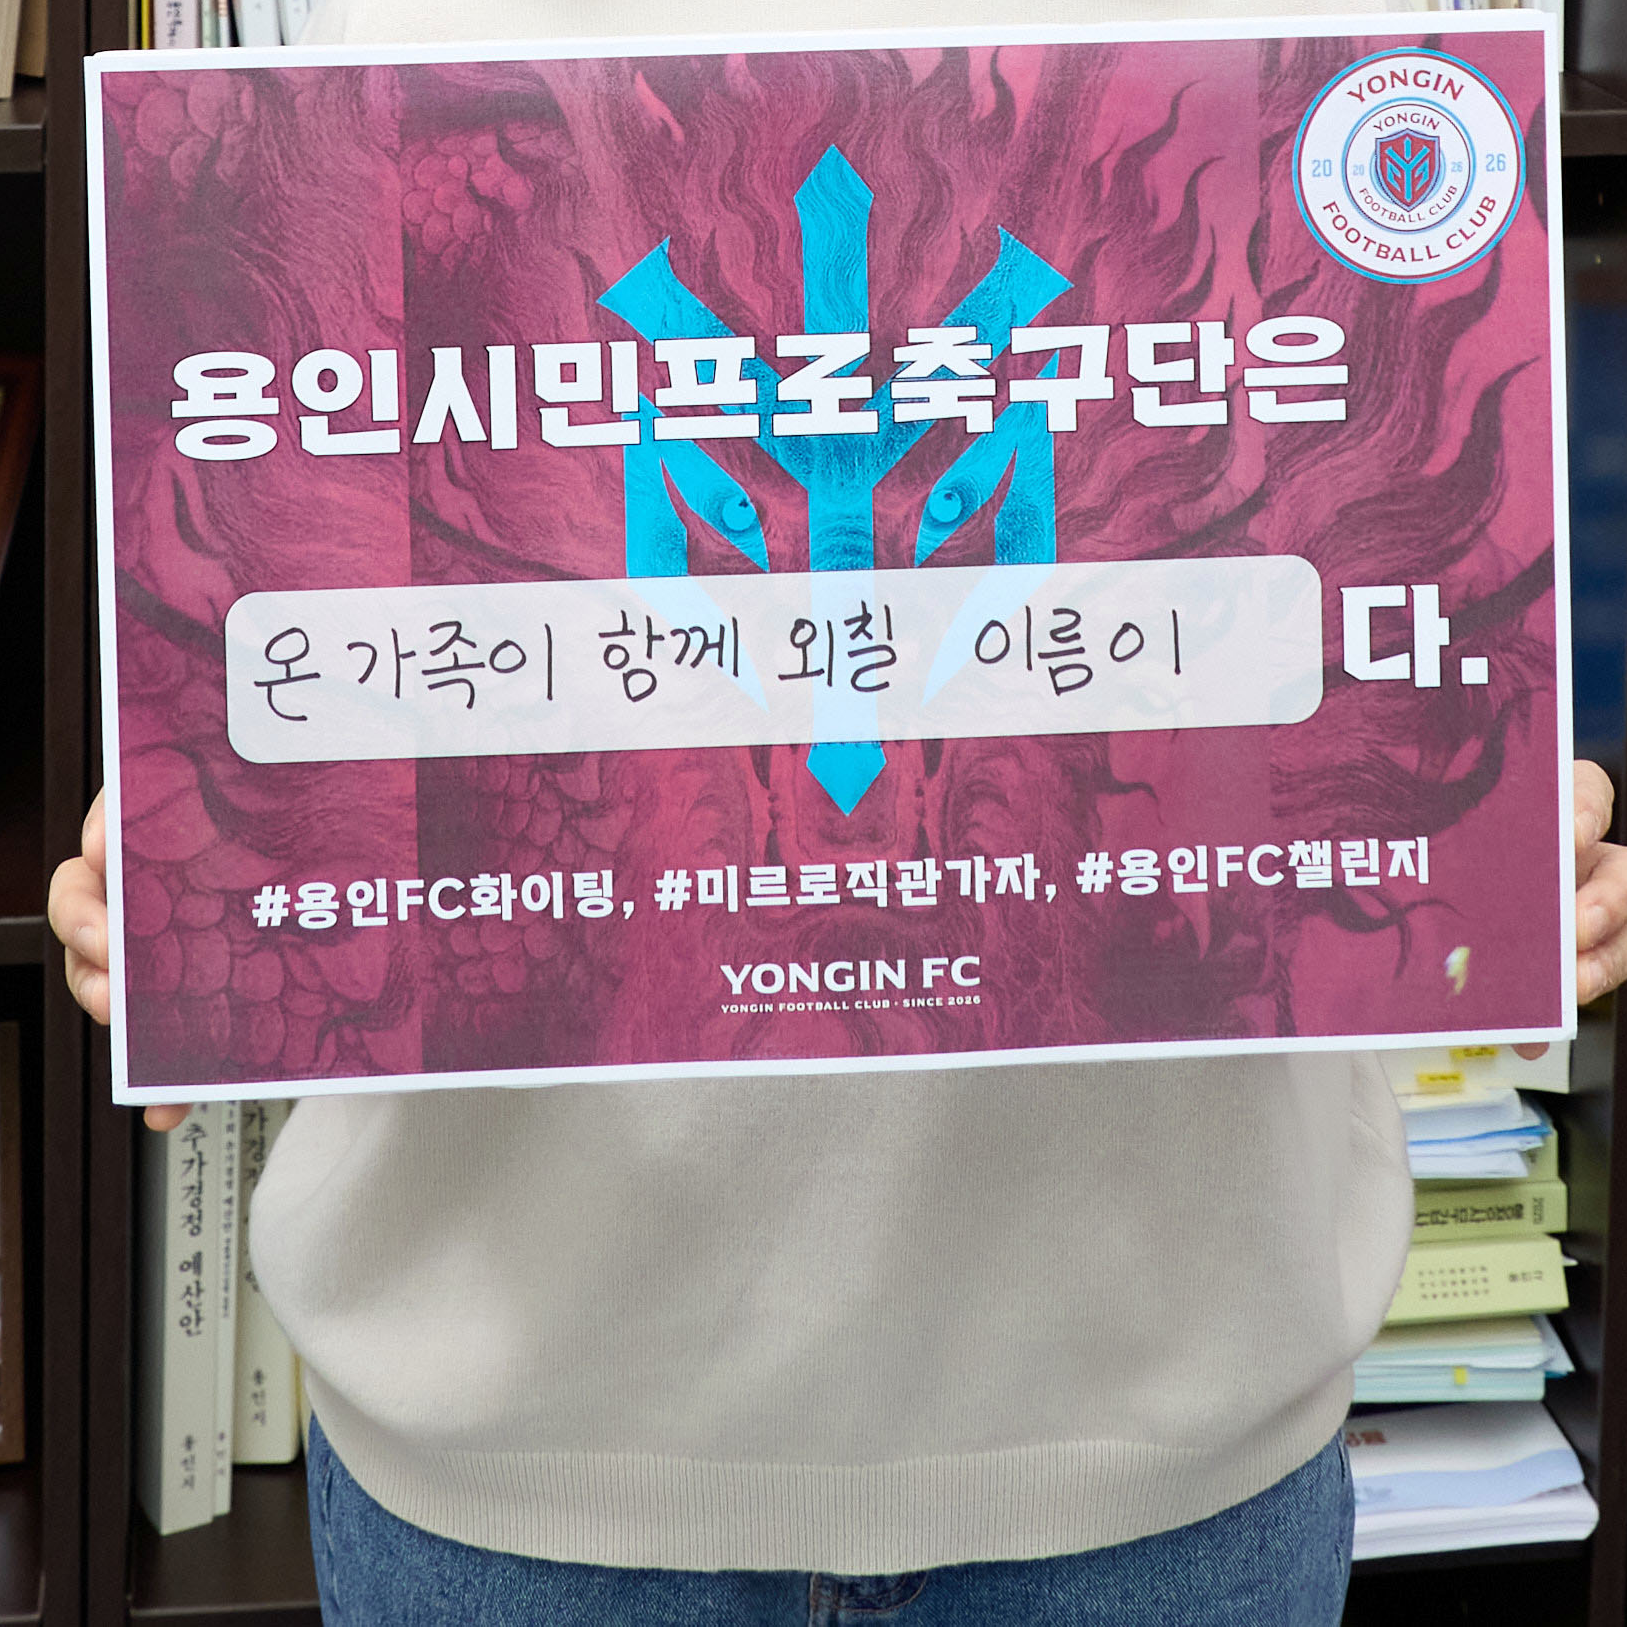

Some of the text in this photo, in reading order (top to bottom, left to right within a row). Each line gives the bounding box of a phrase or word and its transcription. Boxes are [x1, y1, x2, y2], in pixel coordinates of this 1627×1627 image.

[1347, 68, 1465, 103] YONGIN
[1374, 112, 1440, 132] YONGIN
[1312, 154, 1506, 177] 20 26
[1323, 195, 1496, 262] FOOTBALL CLUB
[1359, 185, 1458, 223] FOOTBALL CLUB
[171, 316, 1349, 463] 용인시민프로축구단은
[599, 610, 741, 705] 함께
[779, 600, 897, 718] 외칠
[1341, 583, 1491, 689] 다.
[251, 837, 1431, 931] #용인FC화이팅, #미르로직관가자, #용인FC챌린지
[720, 955, 980, 994] YONGIN FC
[721, 994, 981, 1014] YONGIN FOOTBALL CLUB SINCE 2026
[180, 1122, 207, 1237] 추가경정
